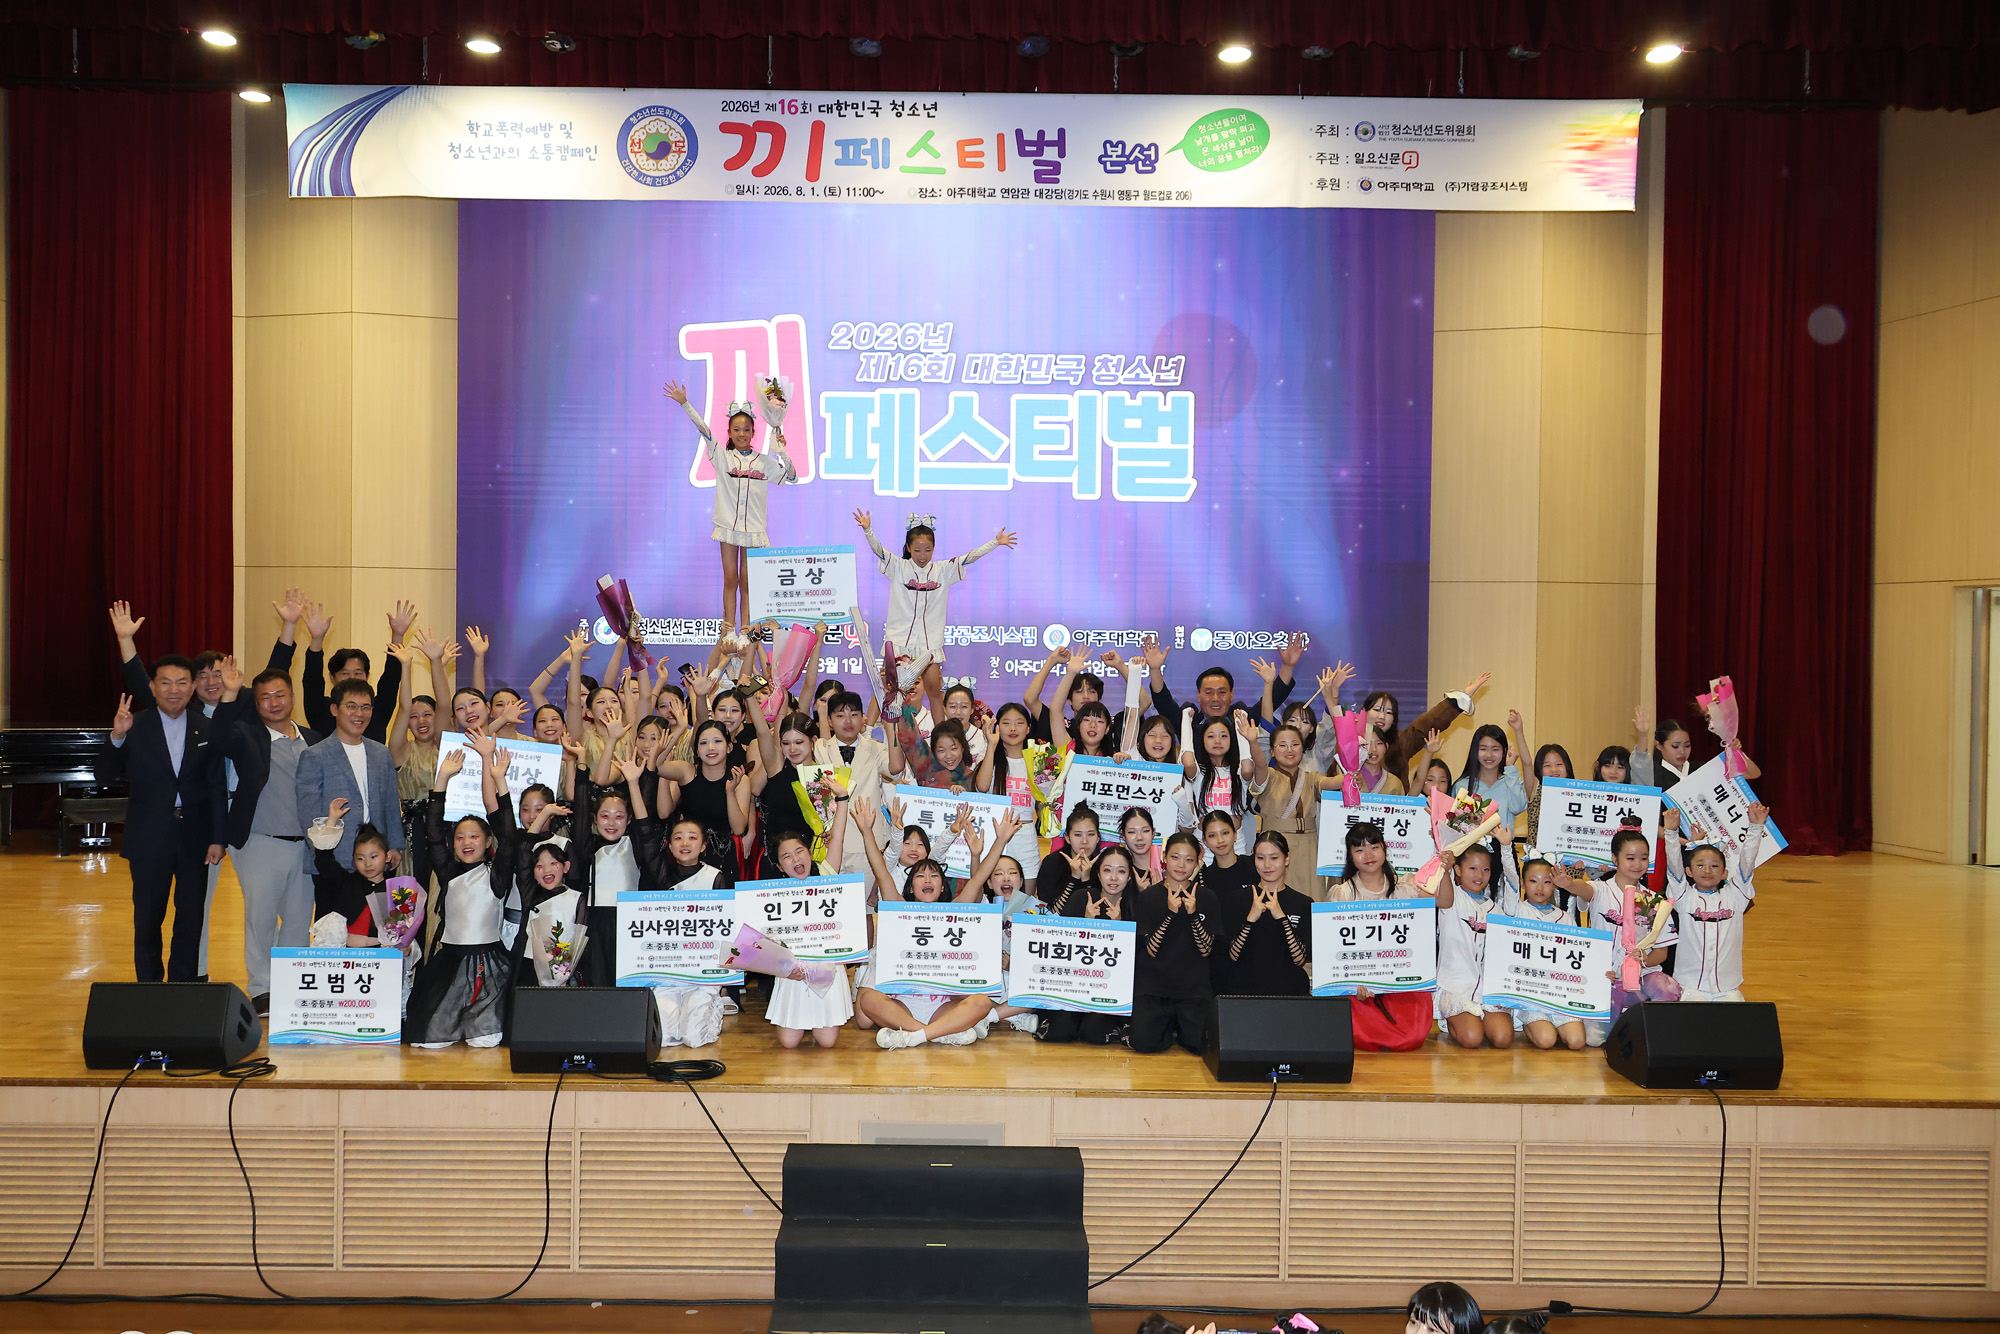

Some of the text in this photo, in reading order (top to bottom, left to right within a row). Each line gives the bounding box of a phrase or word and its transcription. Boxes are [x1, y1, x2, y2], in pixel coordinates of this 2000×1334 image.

[721, 98, 938, 119] 2026년 제16회 대한민국 청소년
[466, 119, 573, 140] 학교폭력예방 및
[1198, 114, 1247, 134] 청소년들이여
[1315, 124, 1340, 138] 주최
[1391, 123, 1476, 137] 청소년선도위원회
[448, 142, 599, 163] 청소년과의 소통캠페인
[629, 138, 642, 154] 선
[719, 119, 1159, 184] 끼페스티벌 본선
[1315, 152, 1340, 165] 주관
[1354, 152, 1401, 165] 일요신문
[638, 174, 654, 186] 사회
[676, 158, 695, 178] 청소년
[735, 184, 760, 197] 일시:
[764, 185, 791, 197] 2026.
[796, 185, 807, 197] 8.
[810, 186, 820, 197] 1.
[823, 185, 842, 198] (토)
[918, 186, 942, 199] 장소:
[947, 186, 997, 200] 아주대학교
[1001, 187, 1030, 200] 연암관
[1092, 189, 1115, 201] 수원시
[1117, 189, 1140, 201] 영통구
[1143, 189, 1173, 201] 월드컵로
[1175, 190, 1192, 202] 206)
[1316, 179, 1341, 191] 후원
[1377, 180, 1528, 193] 아주대학교 (주)가람공조시스템
[827, 321, 953, 351] 2026년
[855, 352, 1186, 387] 제16회 대한민국 청소년
[944, 625, 1038, 647] 람공조시스템
[842, 656, 863, 675] 1일
[989, 656, 1001, 679] 장소
[1006, 776, 1031, 791] ET'S
[1081, 780, 1165, 804] 퍼포먼스상
[1211, 776, 1232, 788] LET'
[1009, 792, 1031, 807] EER
[1206, 793, 1232, 806] CHE
[764, 898, 838, 922] 인기상
[628, 918, 734, 938] 심사위원장상
[1339, 924, 1410, 947] 인기상
[1028, 941, 1122, 968] 대회장상
[1513, 941, 1586, 971] 매너상
[298, 973, 375, 994] 모범상
